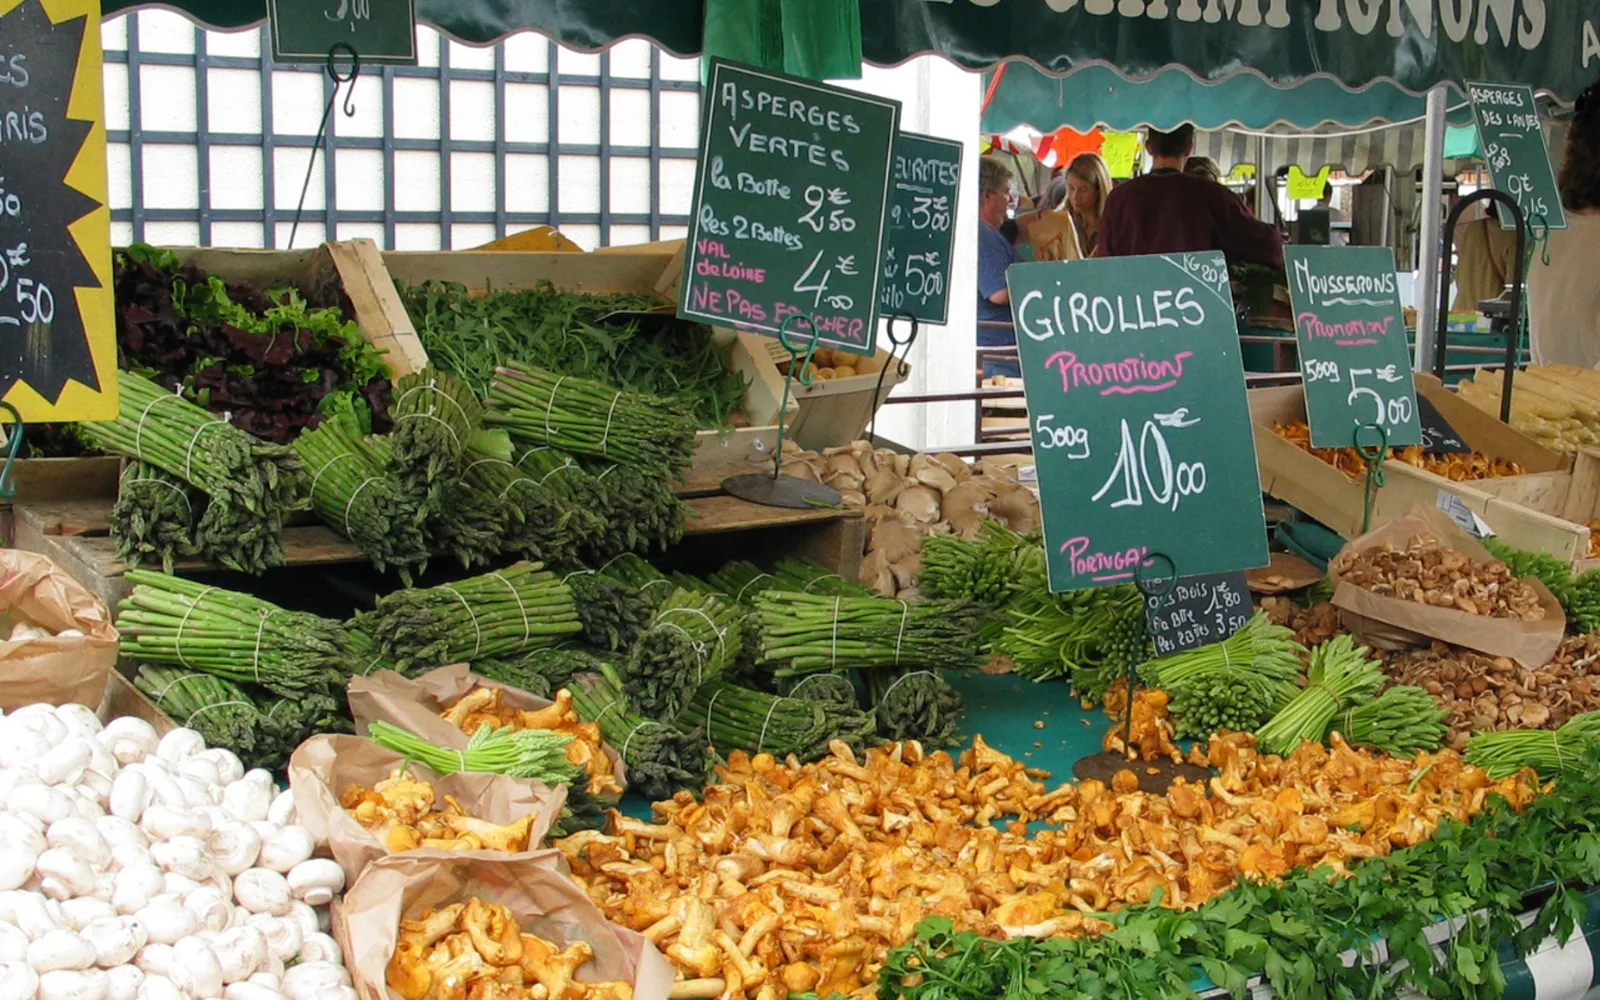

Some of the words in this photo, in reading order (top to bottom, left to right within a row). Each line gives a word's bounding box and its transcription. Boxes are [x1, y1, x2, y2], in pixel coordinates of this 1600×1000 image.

[0, 106, 47, 143] RIS
[722, 82, 861, 134] ASPERGES
[1482, 109, 1502, 127] DES
[729, 123, 850, 172] VERTES
[711, 155, 732, 190] la
[737, 172, 792, 200] Botte
[697, 238, 731, 259] VAL
[733, 215, 749, 239] 2
[751, 223, 803, 250] Bottes
[722, 261, 766, 283] LOIRE
[692, 281, 723, 313] NE
[726, 288, 767, 320] PAS
[1304, 359, 1340, 383] 500g
[1036, 414, 1090, 459] 500g
